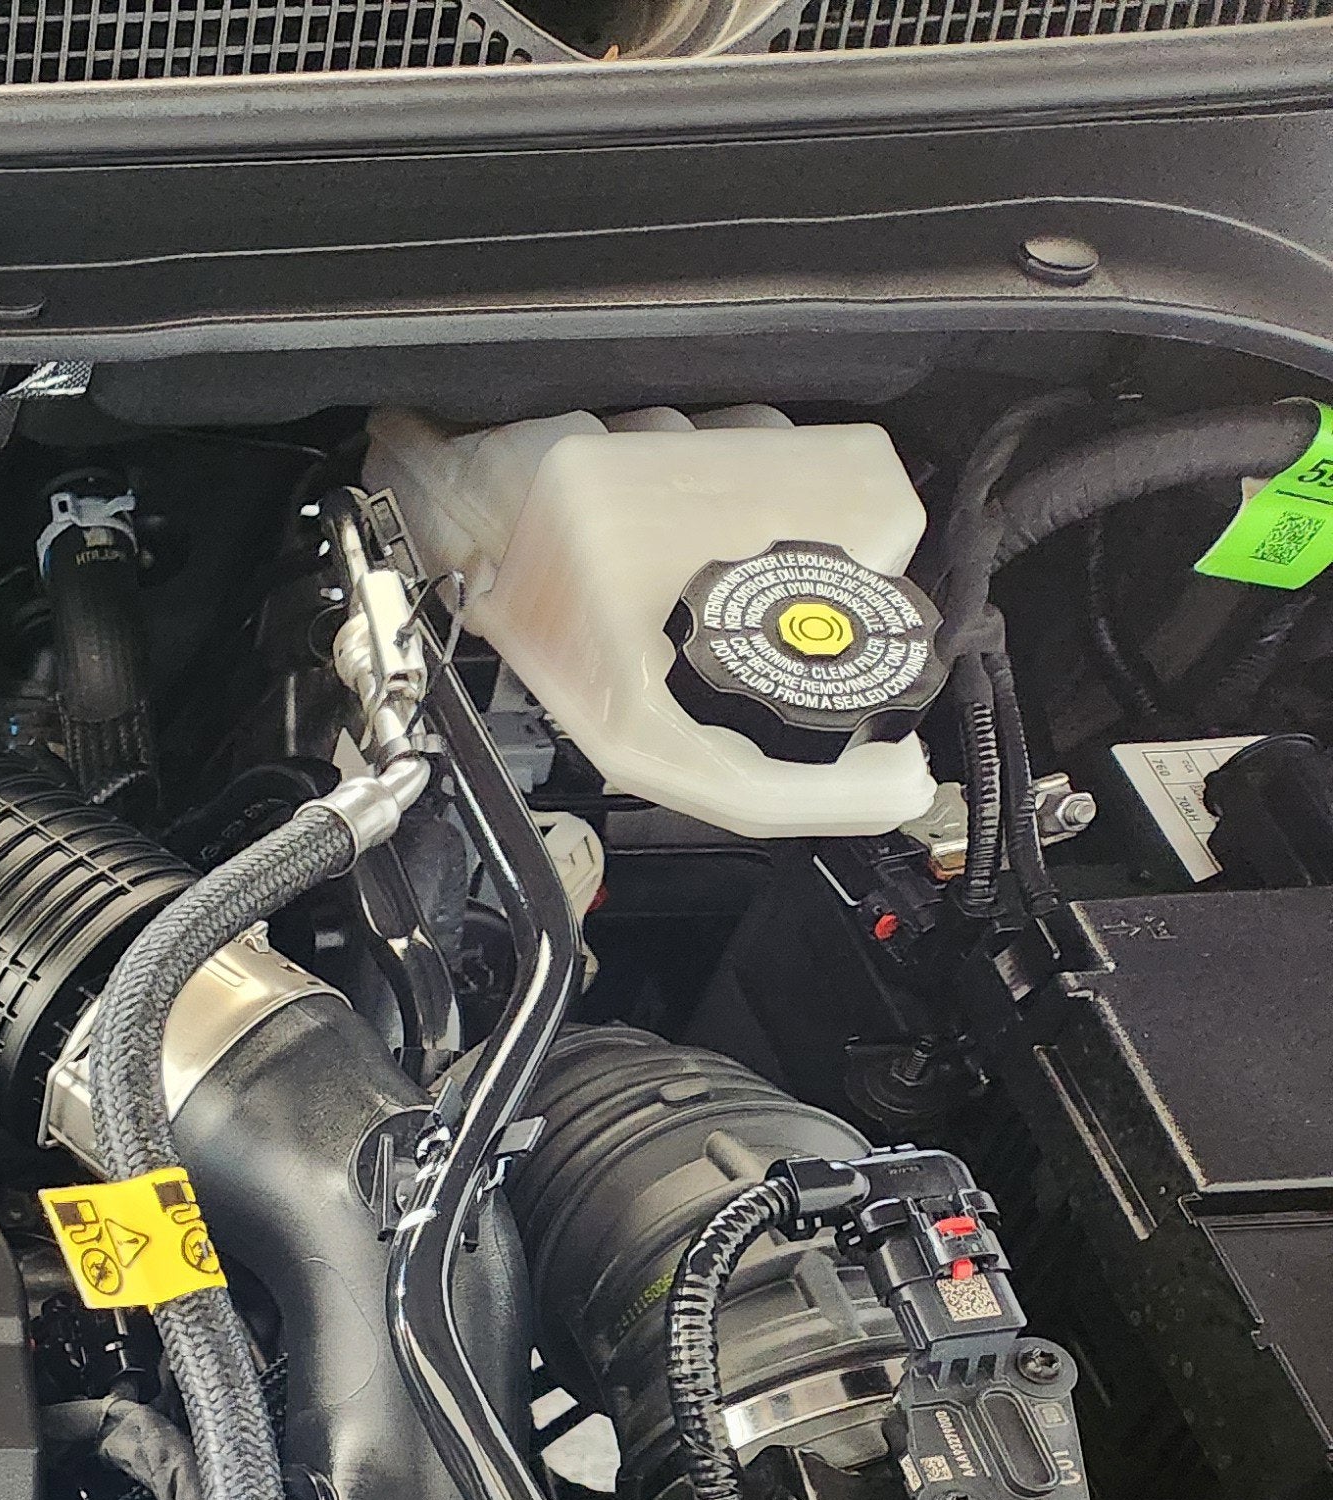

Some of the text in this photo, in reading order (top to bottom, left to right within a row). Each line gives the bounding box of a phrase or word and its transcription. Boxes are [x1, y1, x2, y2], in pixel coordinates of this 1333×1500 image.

[724, 556, 780, 586] NETTOYER
[778, 552, 798, 567] LE
[797, 553, 858, 576] BOUCHON
[853, 568, 893, 595] AVANT
[753, 571, 781, 588] QUE
[776, 567, 796, 582] DU
[795, 567, 843, 587] LIQUIDE
[840, 575, 861, 593] DE
[855, 585, 891, 612] FREIN
[744, 584, 789, 629] PROVENANT
[816, 582, 853, 606] BIDON
[847, 597, 885, 634] SCELLE
[729, 636, 757, 658] CAP
[746, 655, 801, 690] BEFORE
[868, 661, 896, 684] USE
[884, 639, 907, 667] ONLY
[749, 632, 886, 680] WARNING: CLEAN FILLER
[732, 665, 775, 694] FLUID
[773, 685, 819, 709] FROM
[819, 694, 833, 710] A
[832, 688, 889, 711] SEALED
[1152, 758, 1171, 778] 760
